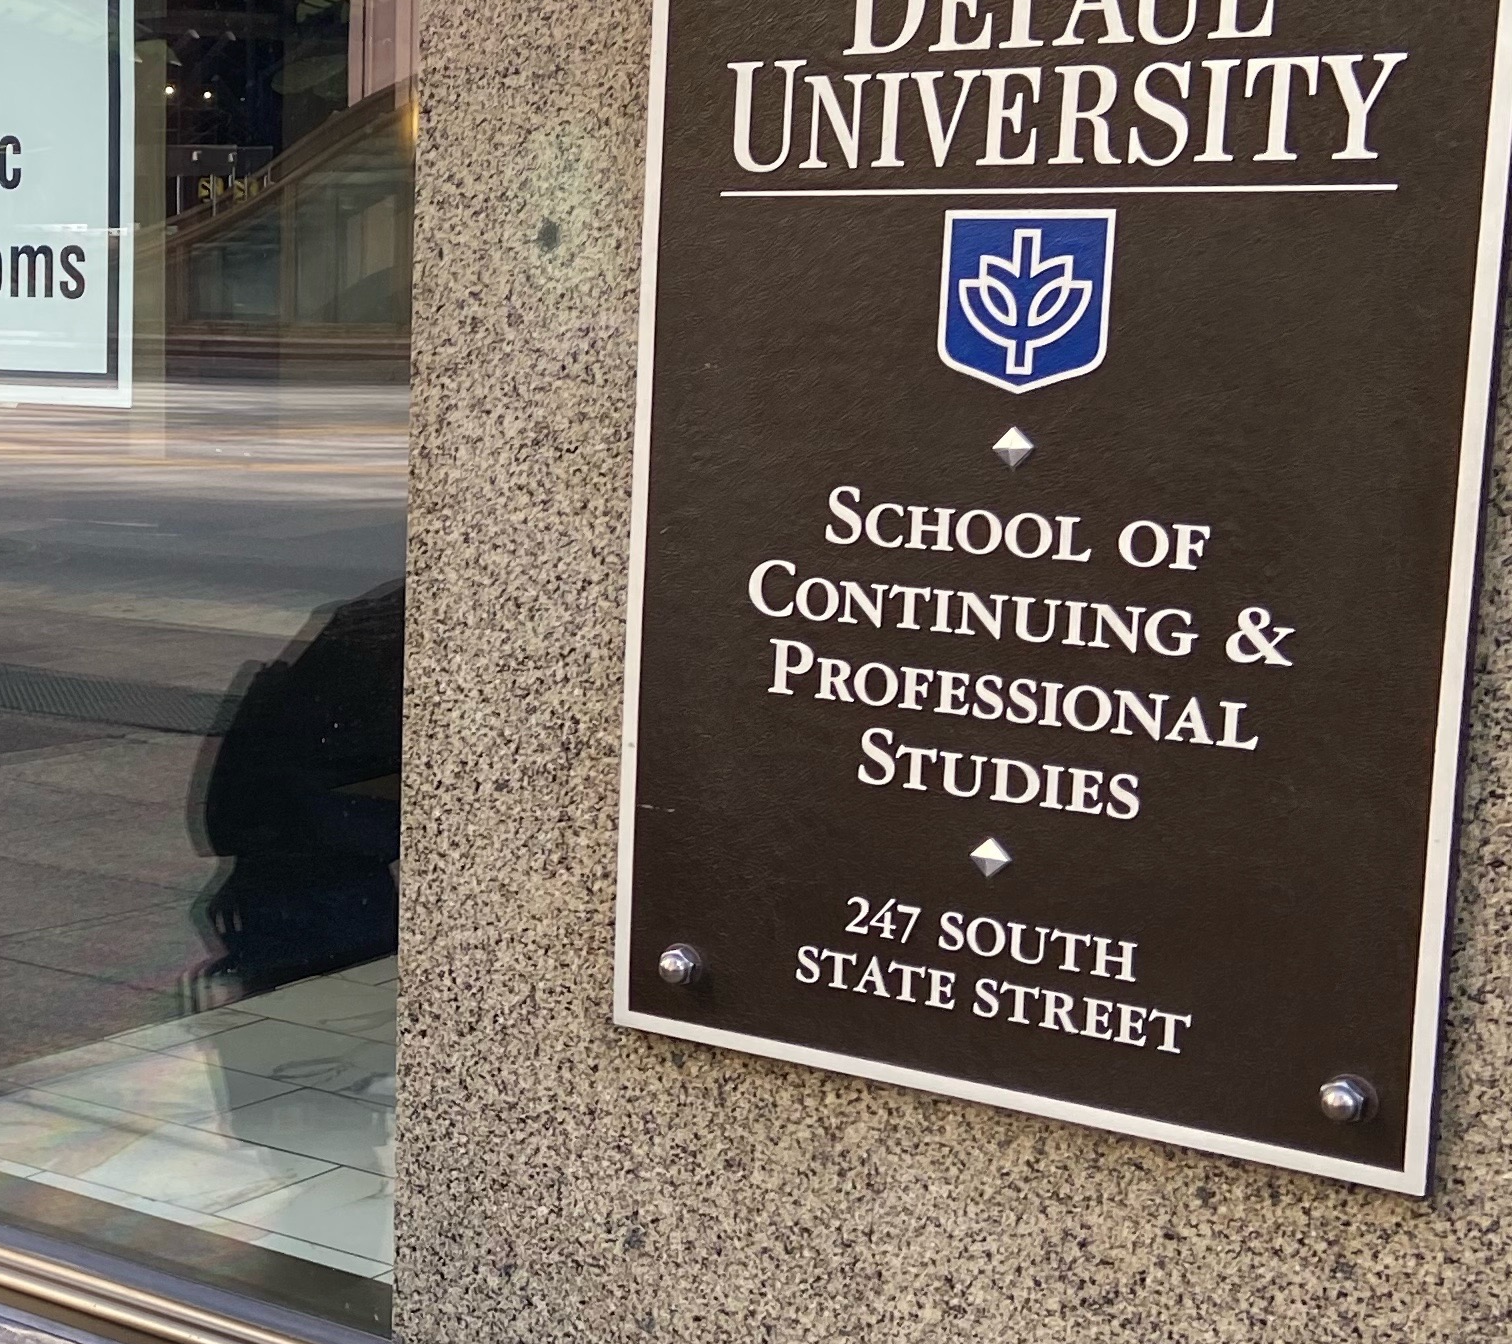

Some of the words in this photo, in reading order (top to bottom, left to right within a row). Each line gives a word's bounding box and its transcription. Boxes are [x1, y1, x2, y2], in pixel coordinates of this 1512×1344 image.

[726, 52, 1408, 173] UNIVERSITY
[825, 485, 1093, 563] SCHOOL
[1118, 520, 1211, 571] OF
[748, 559, 1200, 657] CONTINUING
[1225, 606, 1296, 667] &
[767, 638, 1260, 752] PROFESSIONAL
[857, 727, 1141, 822] STUDIES
[844, 896, 922, 945] 247
[938, 911, 1138, 984] SOUTH
[795, 945, 957, 1011] STATE
[972, 978, 1192, 1054] STREET
